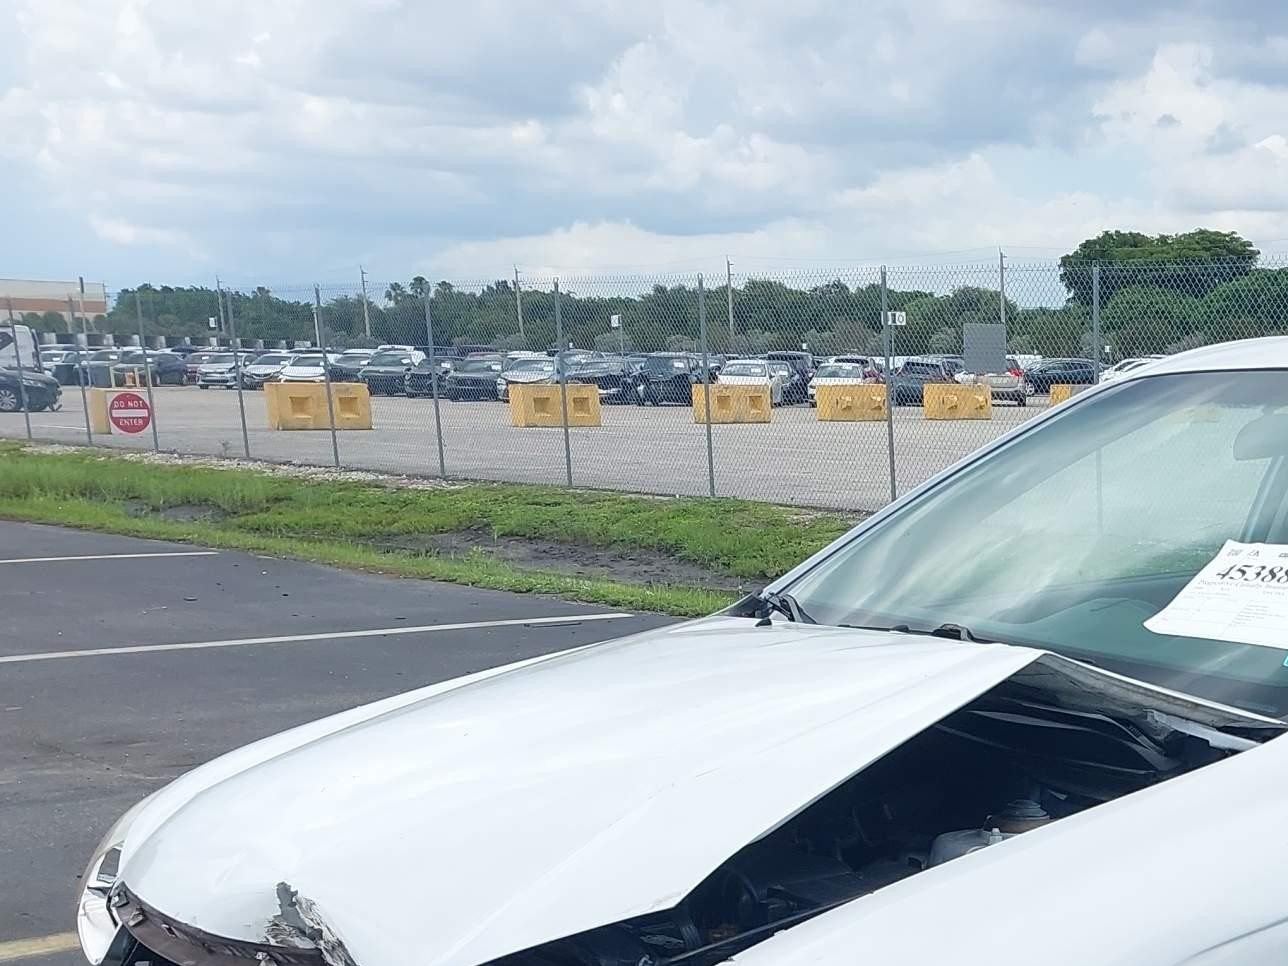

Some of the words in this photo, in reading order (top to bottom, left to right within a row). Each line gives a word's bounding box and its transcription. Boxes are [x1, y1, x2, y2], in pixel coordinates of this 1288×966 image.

[114, 400, 125, 408] DO
[127, 400, 143, 408] NOT
[120, 418, 143, 426] ENTER
